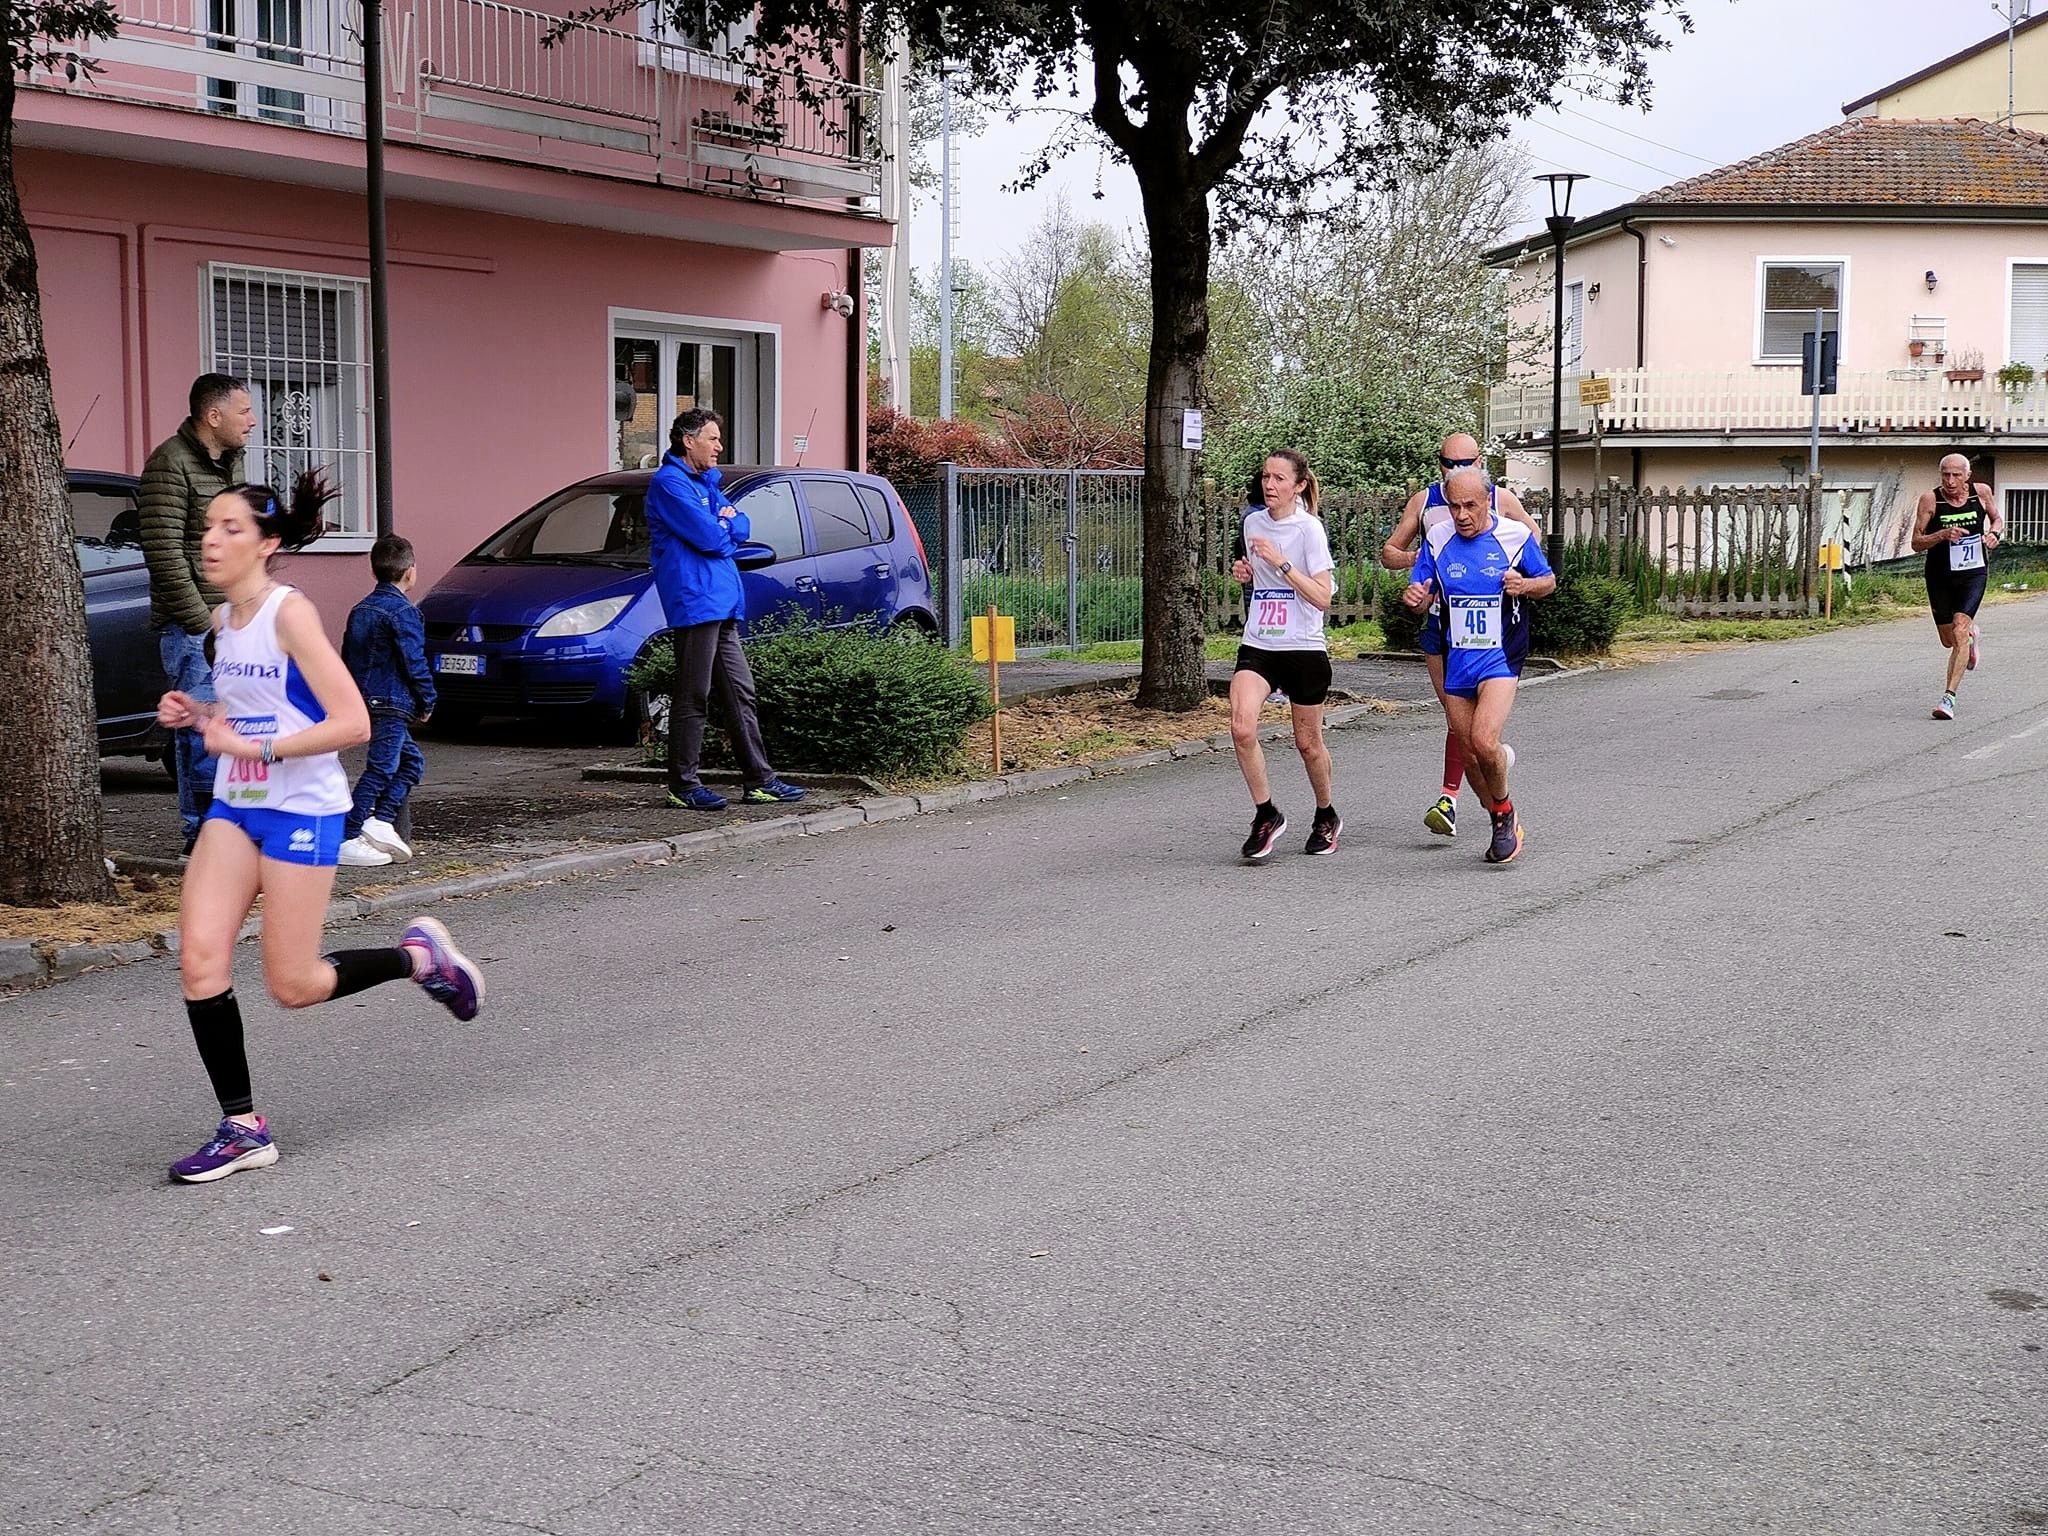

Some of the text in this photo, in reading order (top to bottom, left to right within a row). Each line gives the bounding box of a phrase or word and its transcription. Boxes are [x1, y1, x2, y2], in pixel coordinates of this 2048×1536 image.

[1962, 545, 1974, 561] 21
[1258, 601, 1287, 625] 225
[1465, 610, 1486, 634] 46
